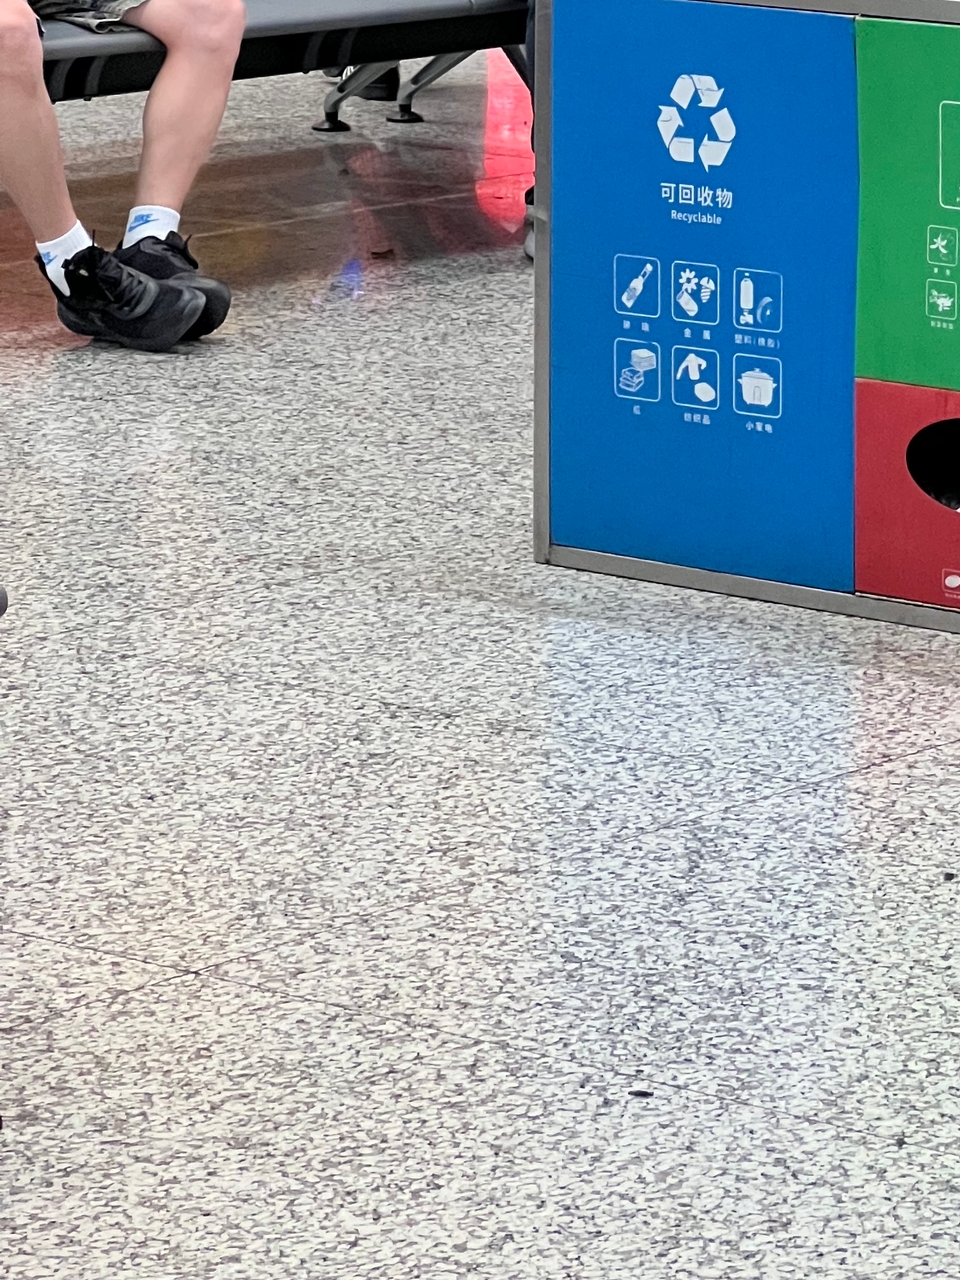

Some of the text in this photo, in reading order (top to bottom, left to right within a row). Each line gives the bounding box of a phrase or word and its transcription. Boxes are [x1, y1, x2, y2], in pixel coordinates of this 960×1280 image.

[659, 182, 733, 209] 可回收物
[671, 209, 723, 225] Recyclable
